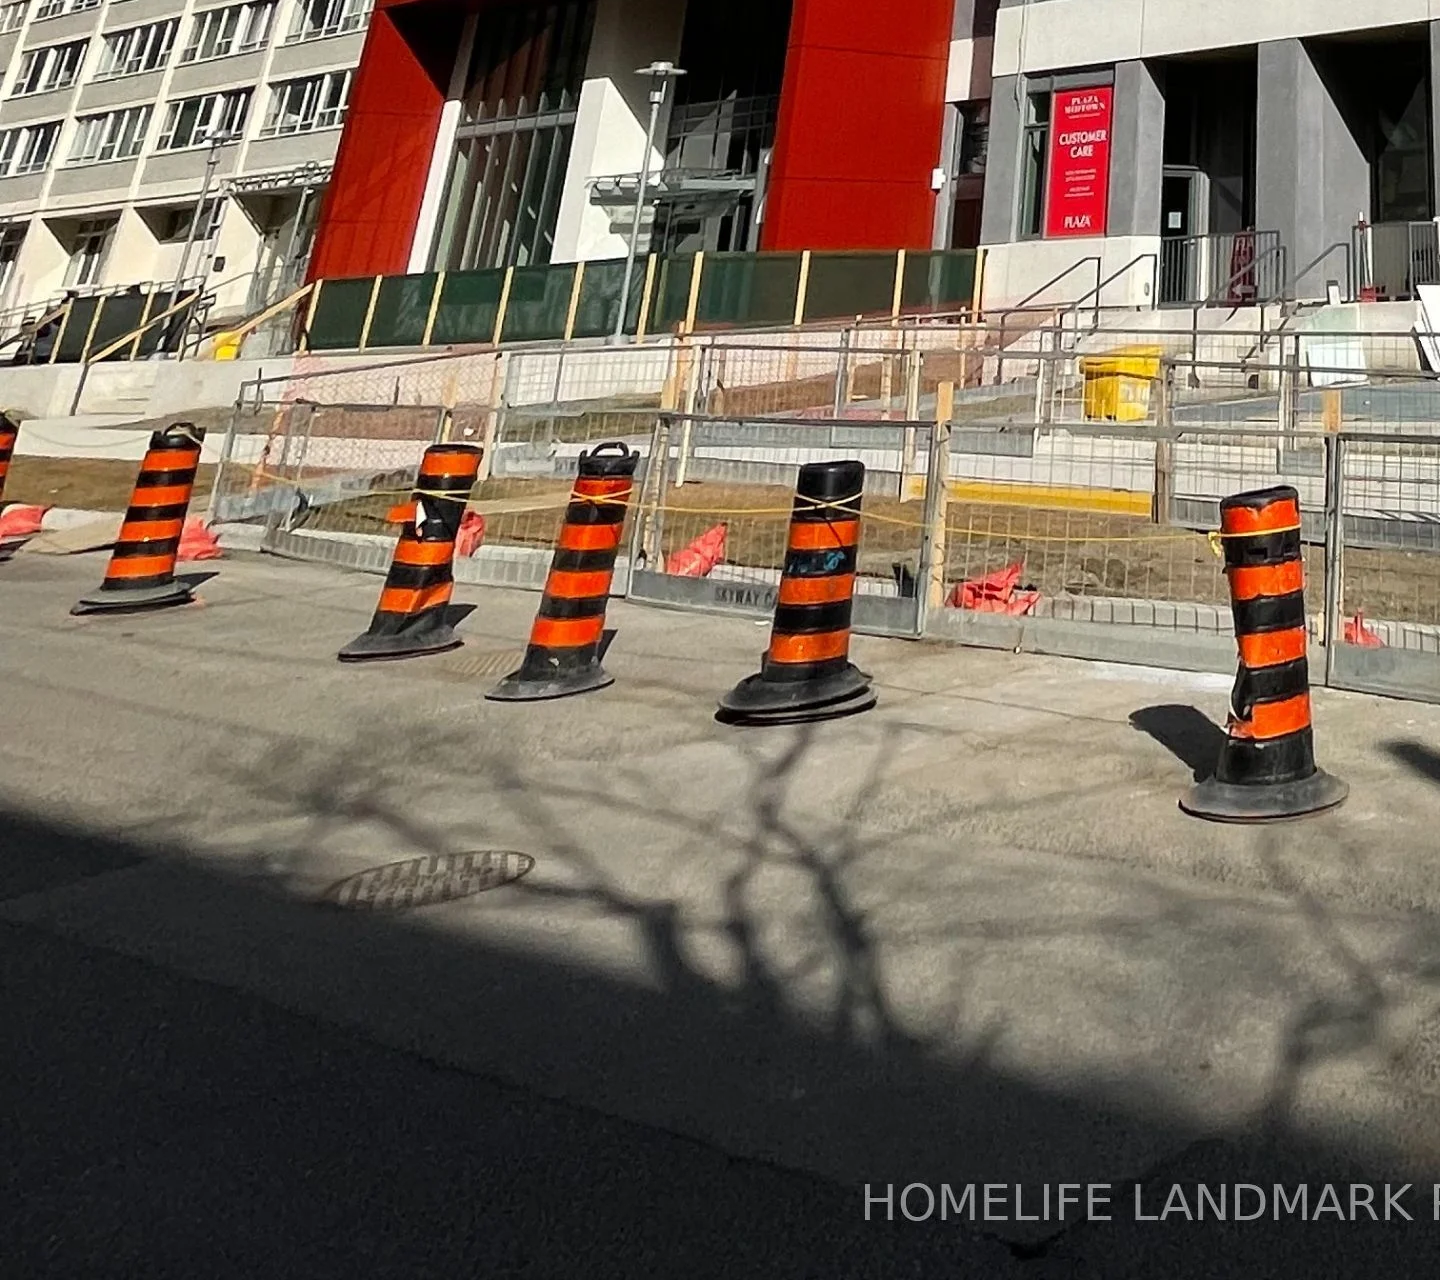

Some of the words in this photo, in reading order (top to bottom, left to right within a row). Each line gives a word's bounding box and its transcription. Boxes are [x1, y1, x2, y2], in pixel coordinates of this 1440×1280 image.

[1071, 96, 1099, 106] PLAZA
[1058, 129, 1107, 146] CUSTOMER
[1070, 144, 1094, 159] CARE
[1064, 214, 1091, 229] PLAZA
